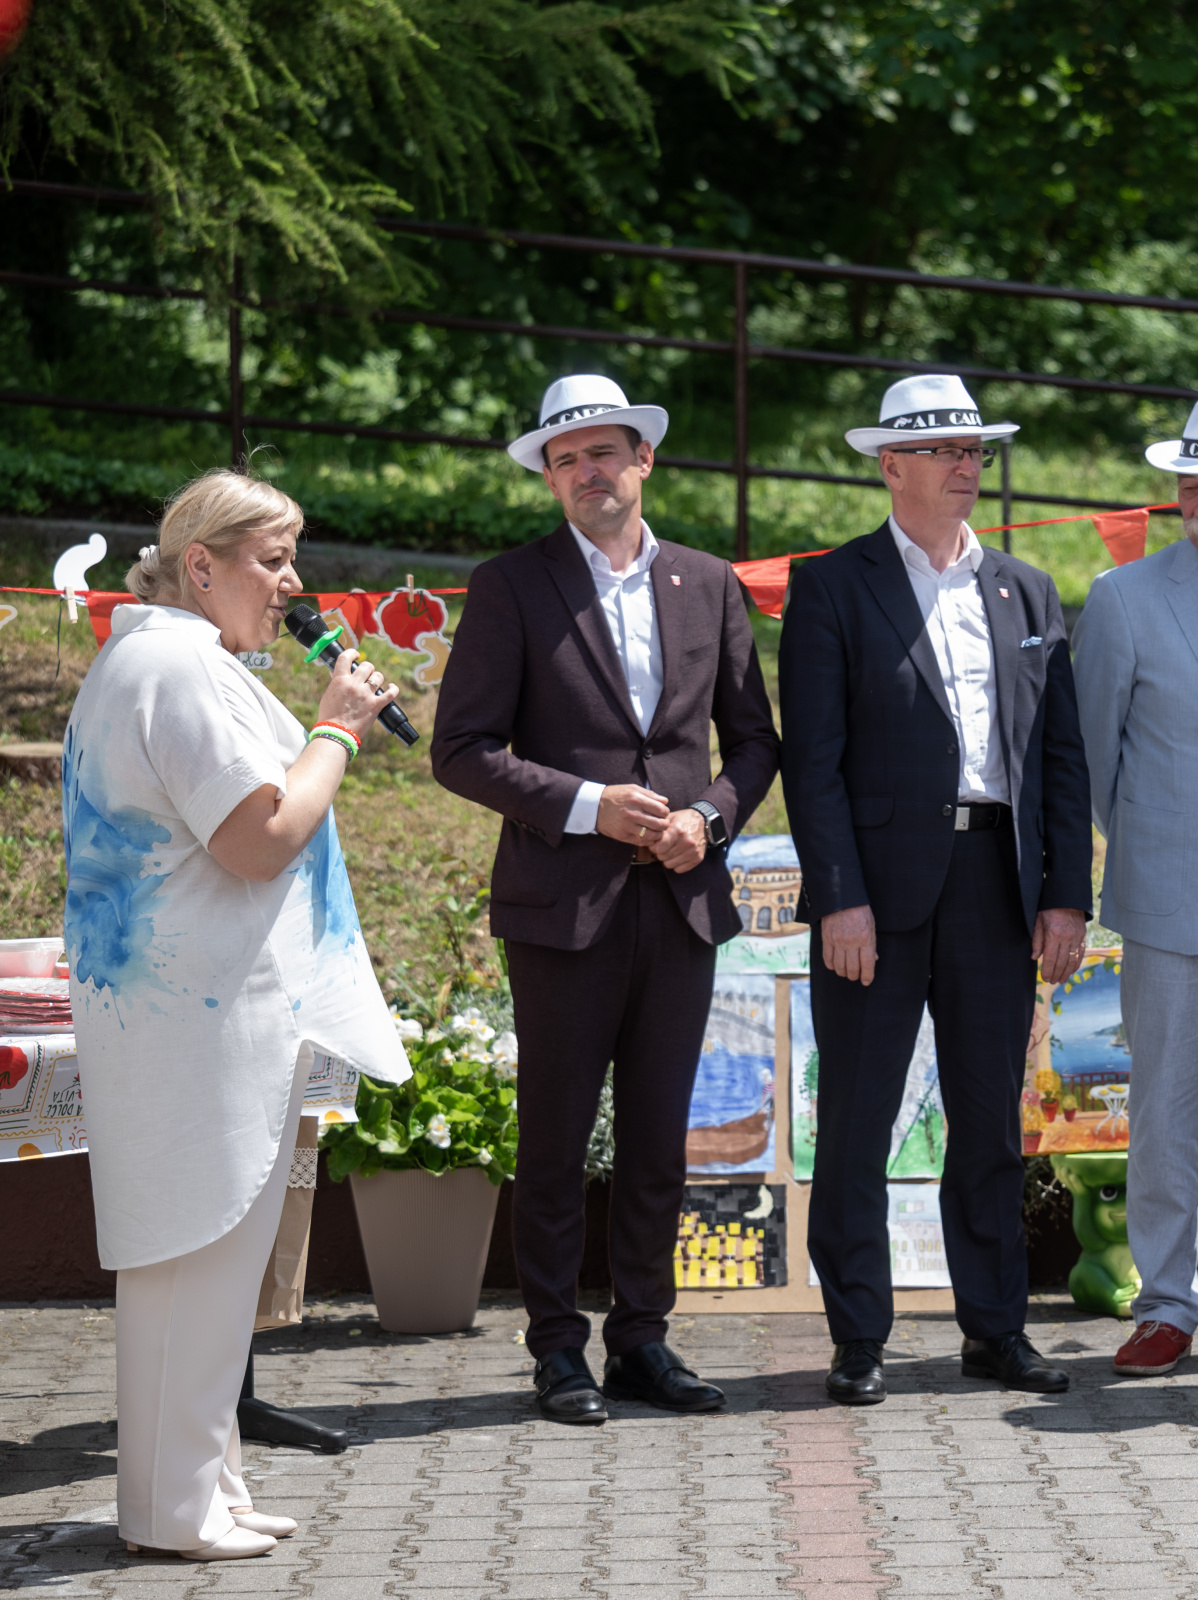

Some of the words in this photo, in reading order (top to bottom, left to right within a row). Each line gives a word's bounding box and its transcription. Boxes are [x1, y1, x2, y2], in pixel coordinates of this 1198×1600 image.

[913, 413, 942, 429] AL
[53, 1089, 75, 1104] VITA
[44, 1103, 75, 1118] DOLCE
